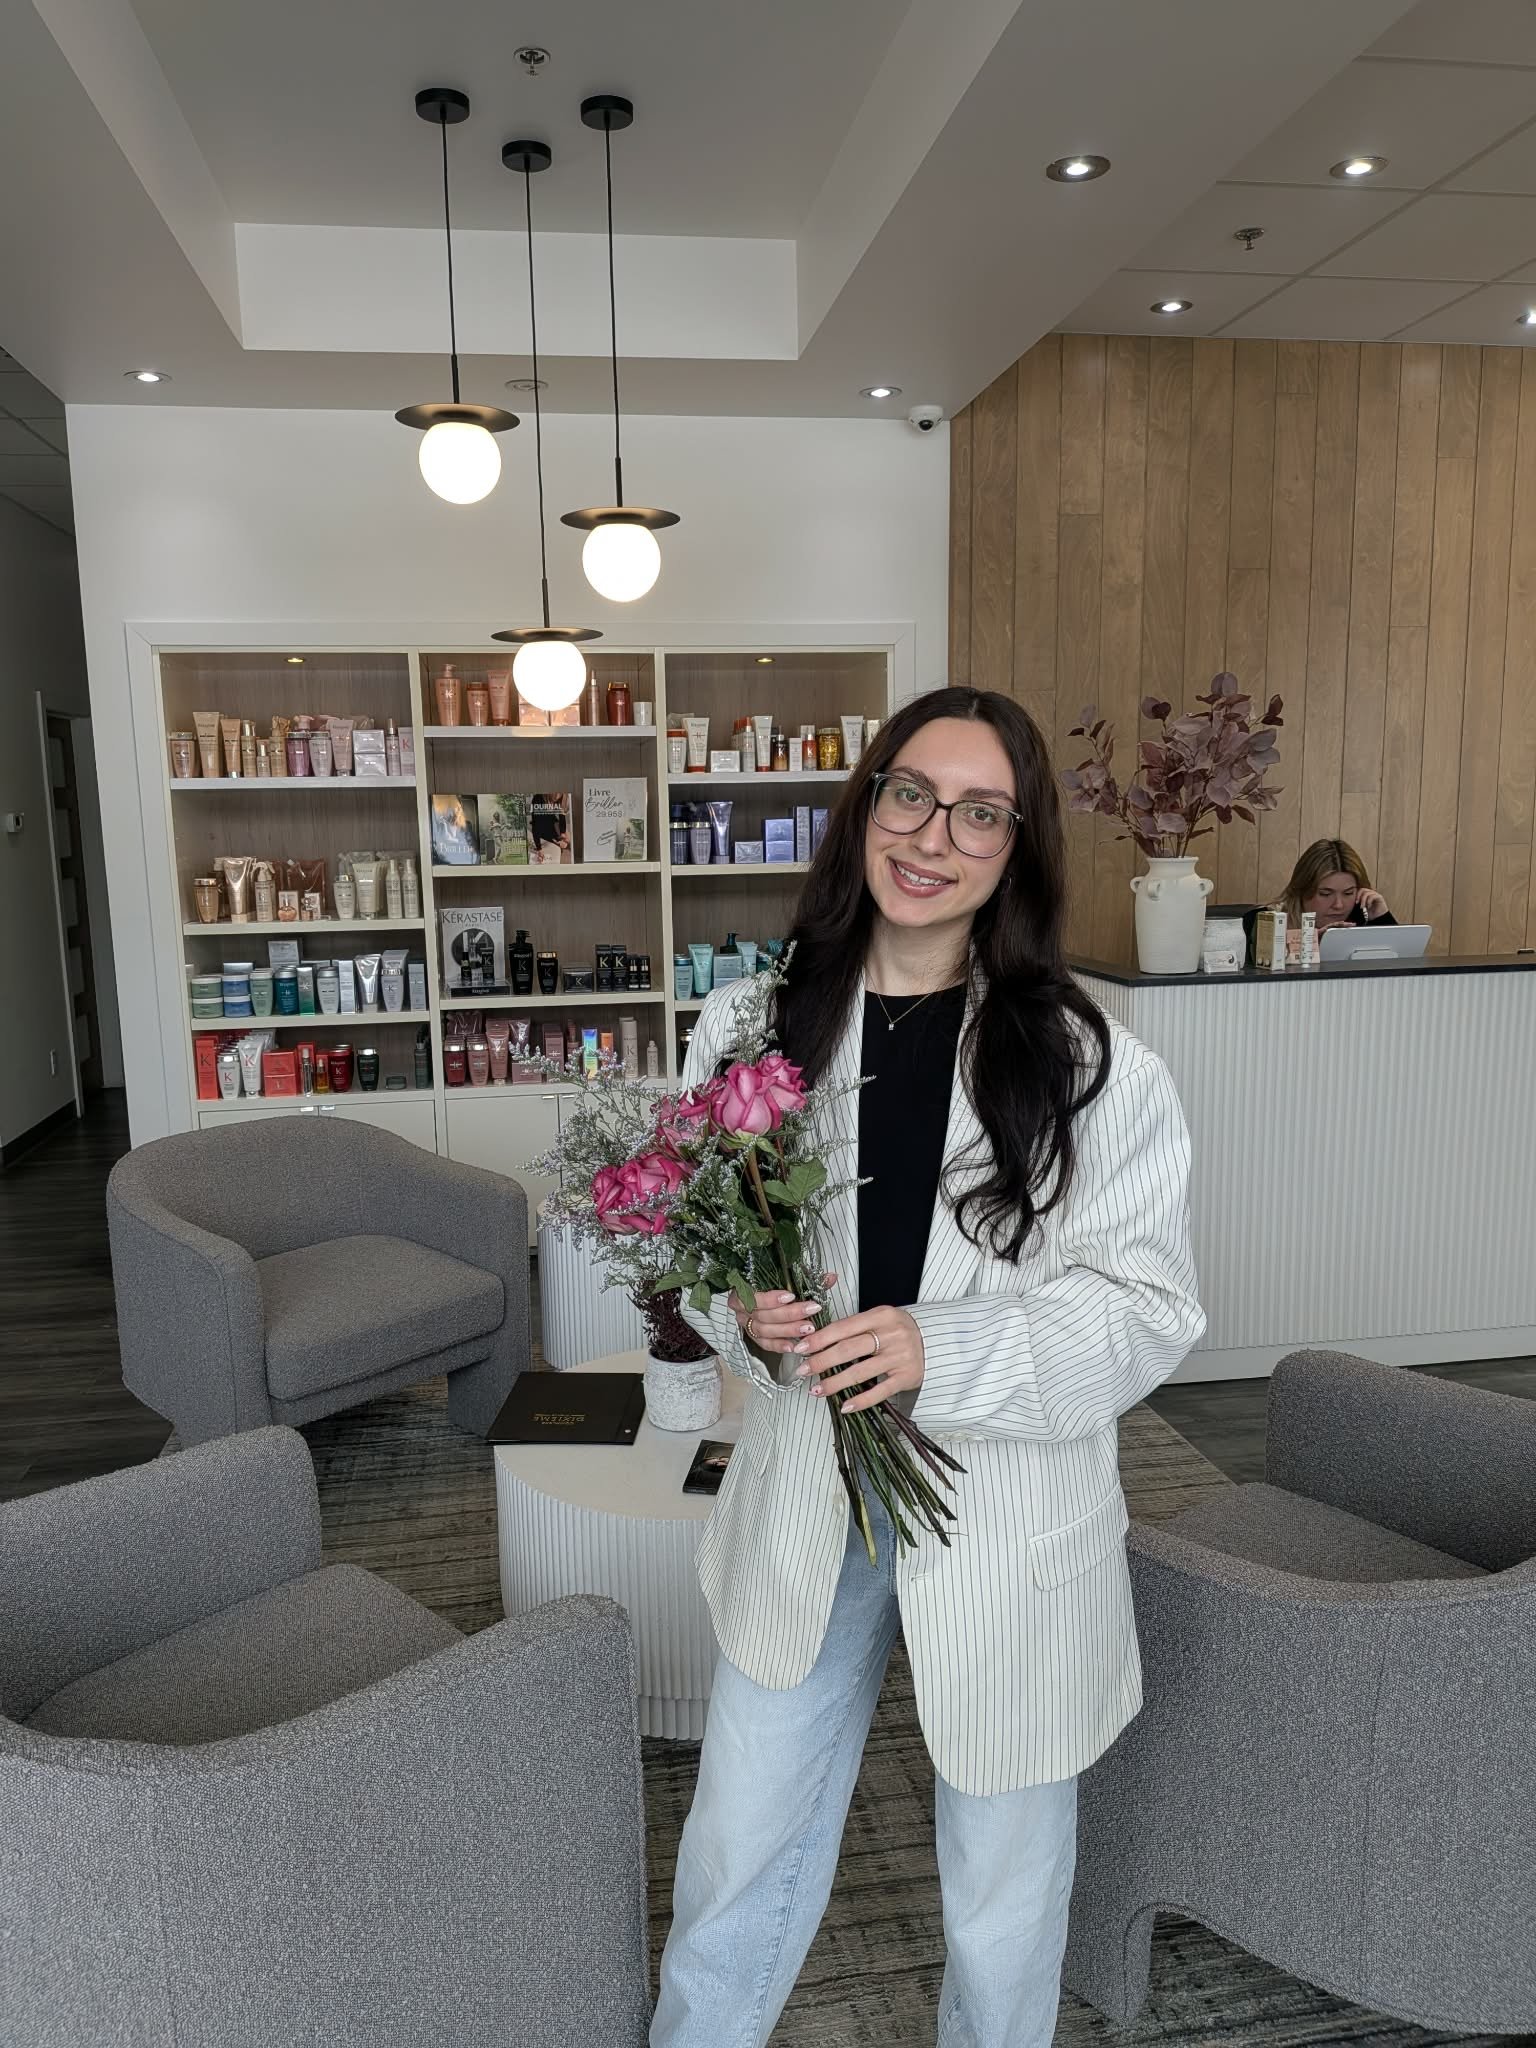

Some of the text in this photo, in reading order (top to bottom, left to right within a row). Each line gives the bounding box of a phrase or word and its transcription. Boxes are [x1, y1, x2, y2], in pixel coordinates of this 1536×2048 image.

[589, 788, 611, 797] Livre
[529, 804, 562, 813] JOURNAL
[442, 911, 503, 924] KÉRASTASE
[518, 960, 527, 971] K
[600, 956, 609, 968] K
[615, 955, 624, 967] K
[201, 1054, 211, 1067] K
[244, 1055, 255, 1067] K
[224, 1072, 232, 1082] K
